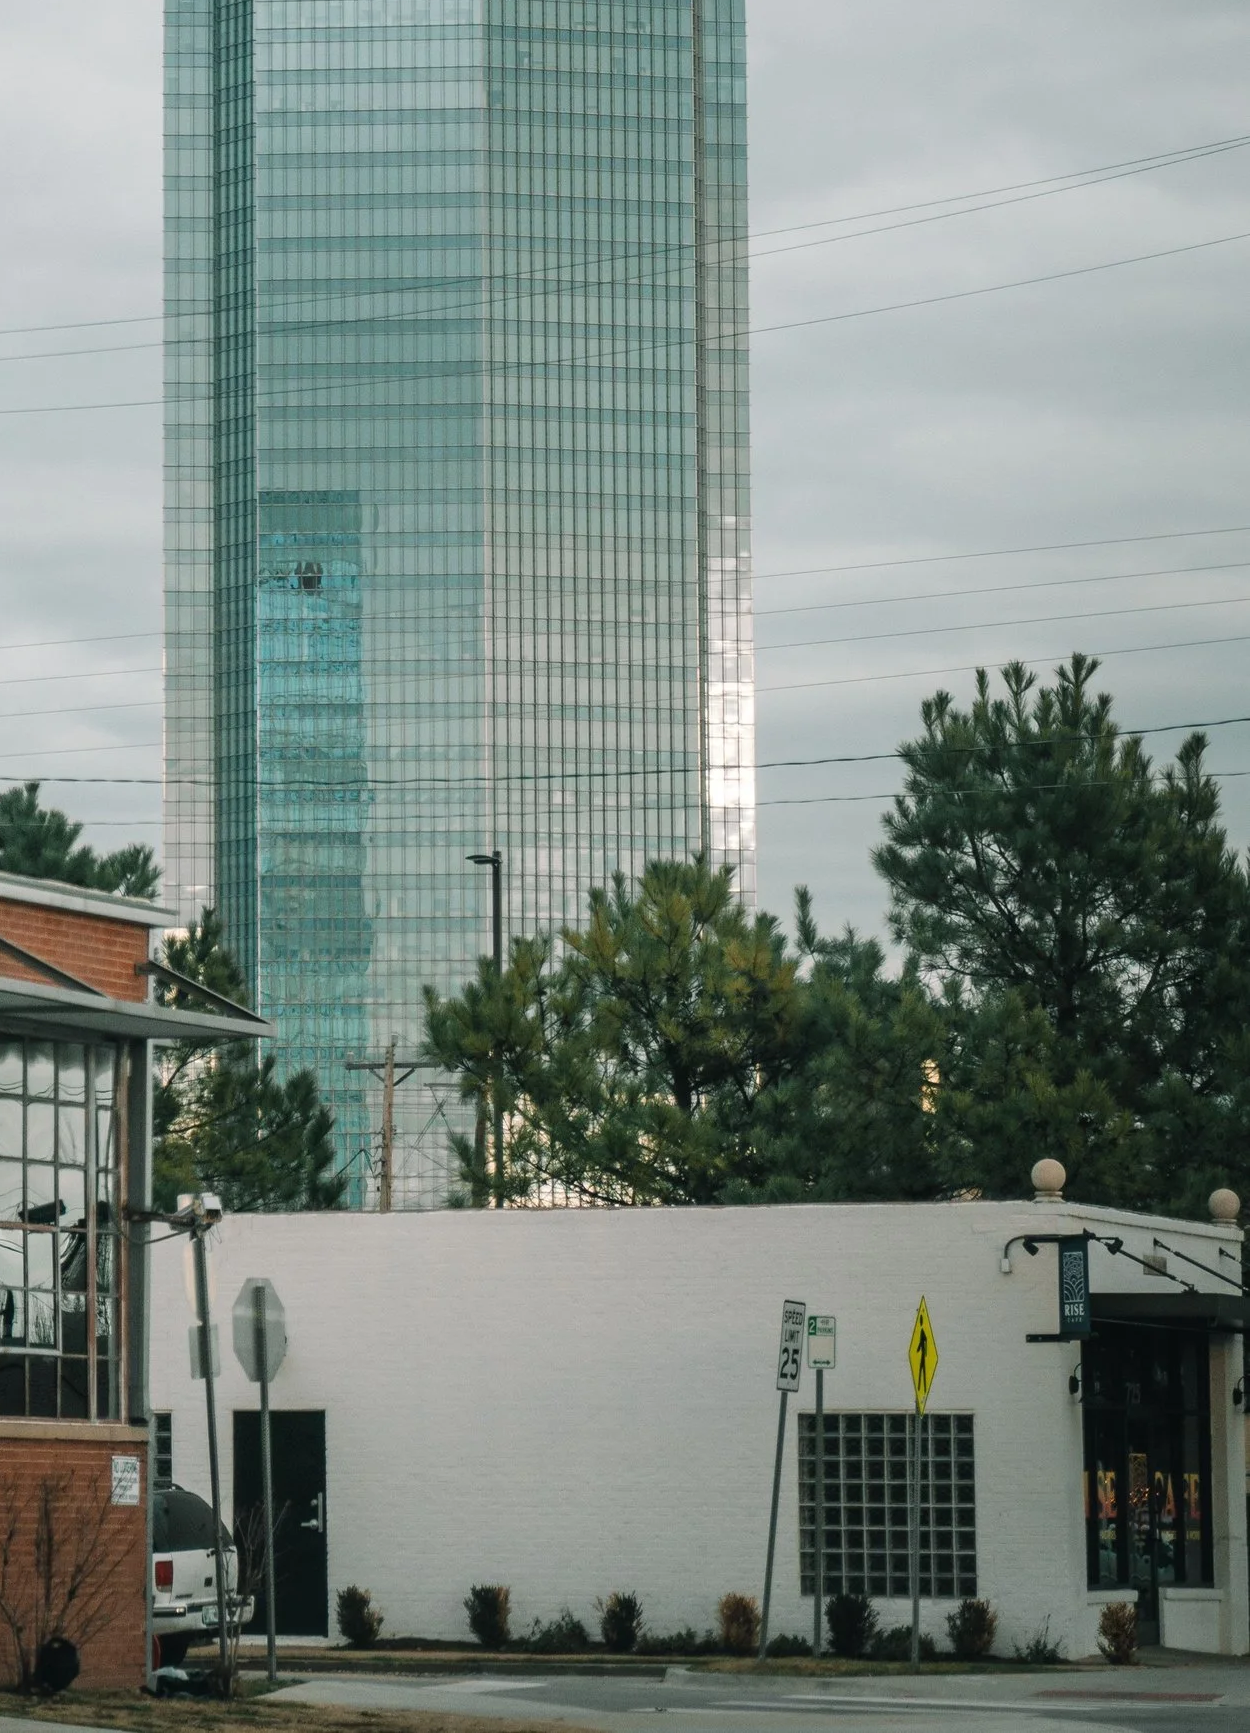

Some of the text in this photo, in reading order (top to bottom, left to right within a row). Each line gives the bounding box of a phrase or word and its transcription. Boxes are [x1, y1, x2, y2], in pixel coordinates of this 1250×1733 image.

[1064, 1303, 1085, 1316] RISE
[784, 1310, 803, 1325] SPEED
[809, 1319, 816, 1333] 2
[784, 1329, 800, 1343] LIMIT
[780, 1347, 800, 1380] 25
